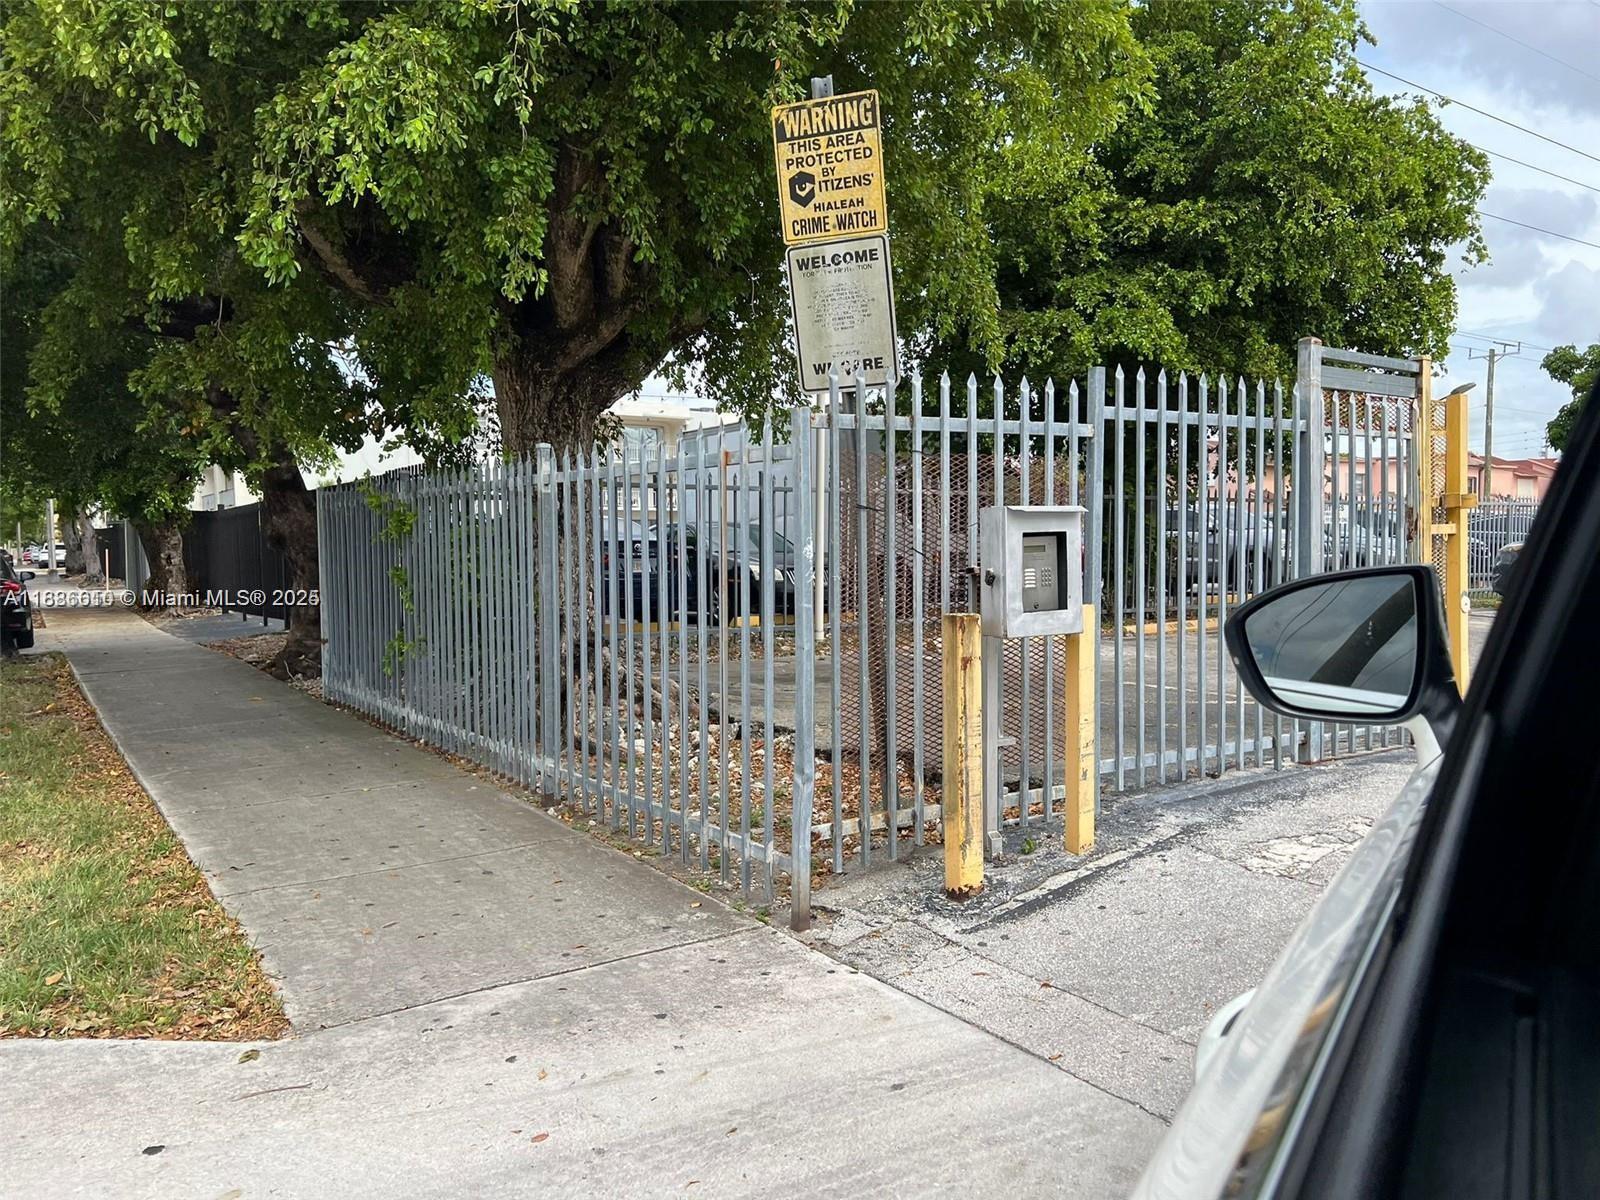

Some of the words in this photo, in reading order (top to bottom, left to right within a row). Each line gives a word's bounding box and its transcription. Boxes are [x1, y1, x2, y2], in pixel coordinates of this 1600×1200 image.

[784, 98, 873, 139] WARNING
[788, 138, 821, 154] THIS
[826, 132, 865, 149] AREA
[786, 147, 873, 170] PROTECTED
[822, 166, 836, 177] BY
[813, 197, 864, 212] HIALEAH
[792, 216, 830, 236] CRIME
[836, 210, 877, 231] WATCH
[796, 248, 879, 271] WELCOME
